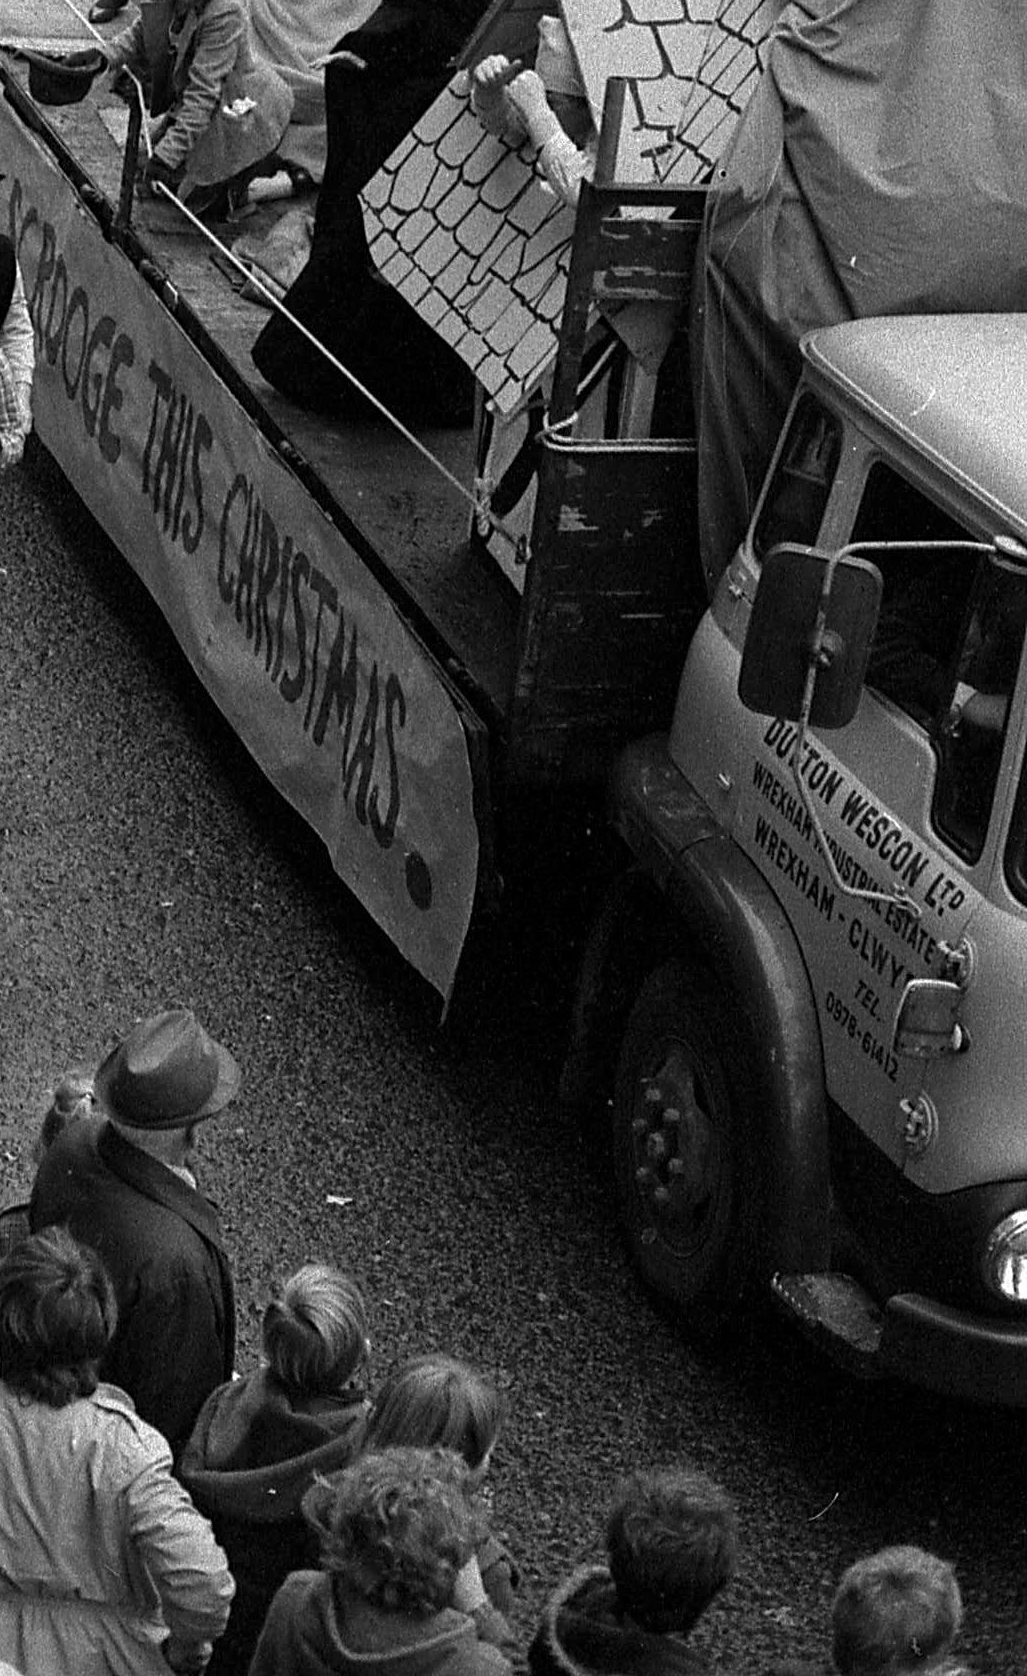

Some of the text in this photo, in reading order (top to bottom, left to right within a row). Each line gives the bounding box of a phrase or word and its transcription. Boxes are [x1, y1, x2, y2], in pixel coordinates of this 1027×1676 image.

[140, 358, 214, 555] THIS
[754, 815, 835, 923] WREXHAM
[848, 917, 914, 990] CLWY
[840, 789, 930, 888] WESCON
[885, 900, 937, 965] ESTATE
